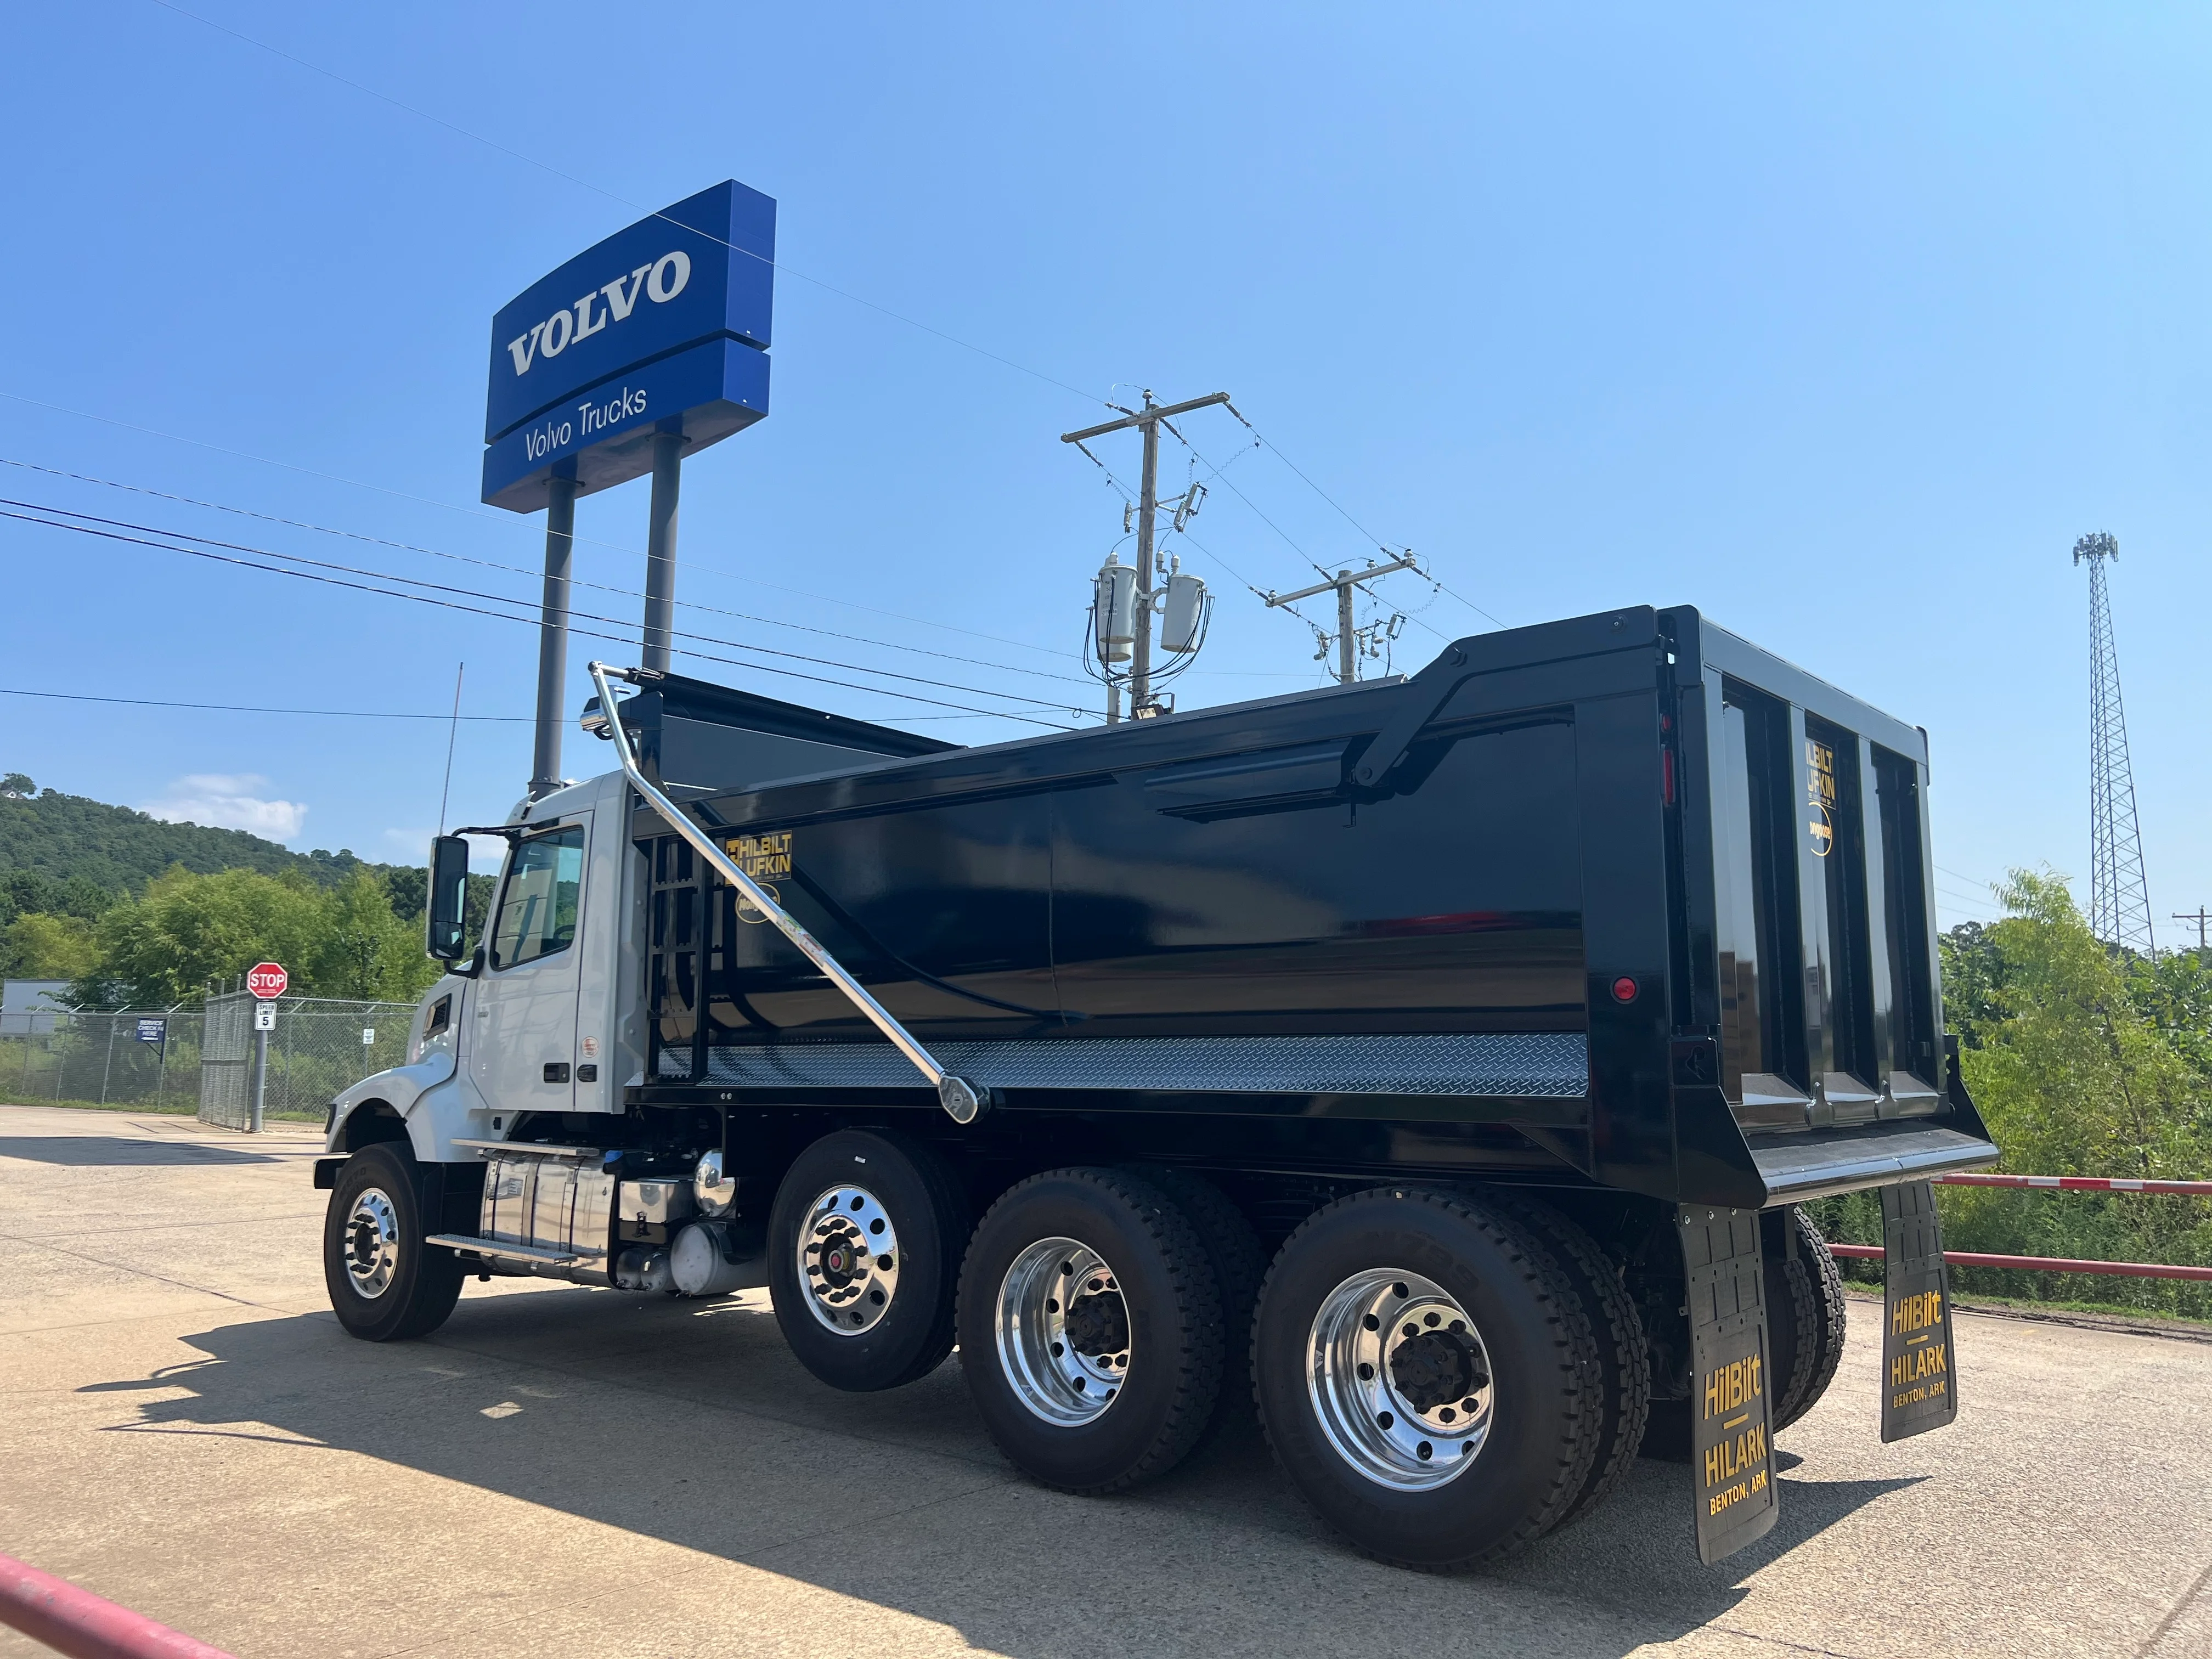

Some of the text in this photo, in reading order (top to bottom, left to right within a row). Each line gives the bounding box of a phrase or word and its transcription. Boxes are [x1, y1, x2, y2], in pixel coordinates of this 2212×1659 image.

[507, 251, 691, 376] VOLVO
[526, 386, 647, 461] Volvo Trucks
[1805, 742, 1833, 774] ILBILT
[1807, 767, 1835, 800] UFKIN
[740, 834, 792, 857] HILBILT
[1809, 821, 1831, 840] ongoose
[251, 973, 285, 987] STOP
[262, 1017, 269, 1026] 5
[1892, 1290, 1942, 1336] HilBilt
[1891, 1344, 1946, 1387] HILARK
[1703, 1353, 1761, 1420] HilBilt
[1893, 1380, 1945, 1408] BENTON, ARK
[1705, 1422, 1767, 1487] HILARK
[1709, 1469, 1767, 1516] BENTON, ARK
